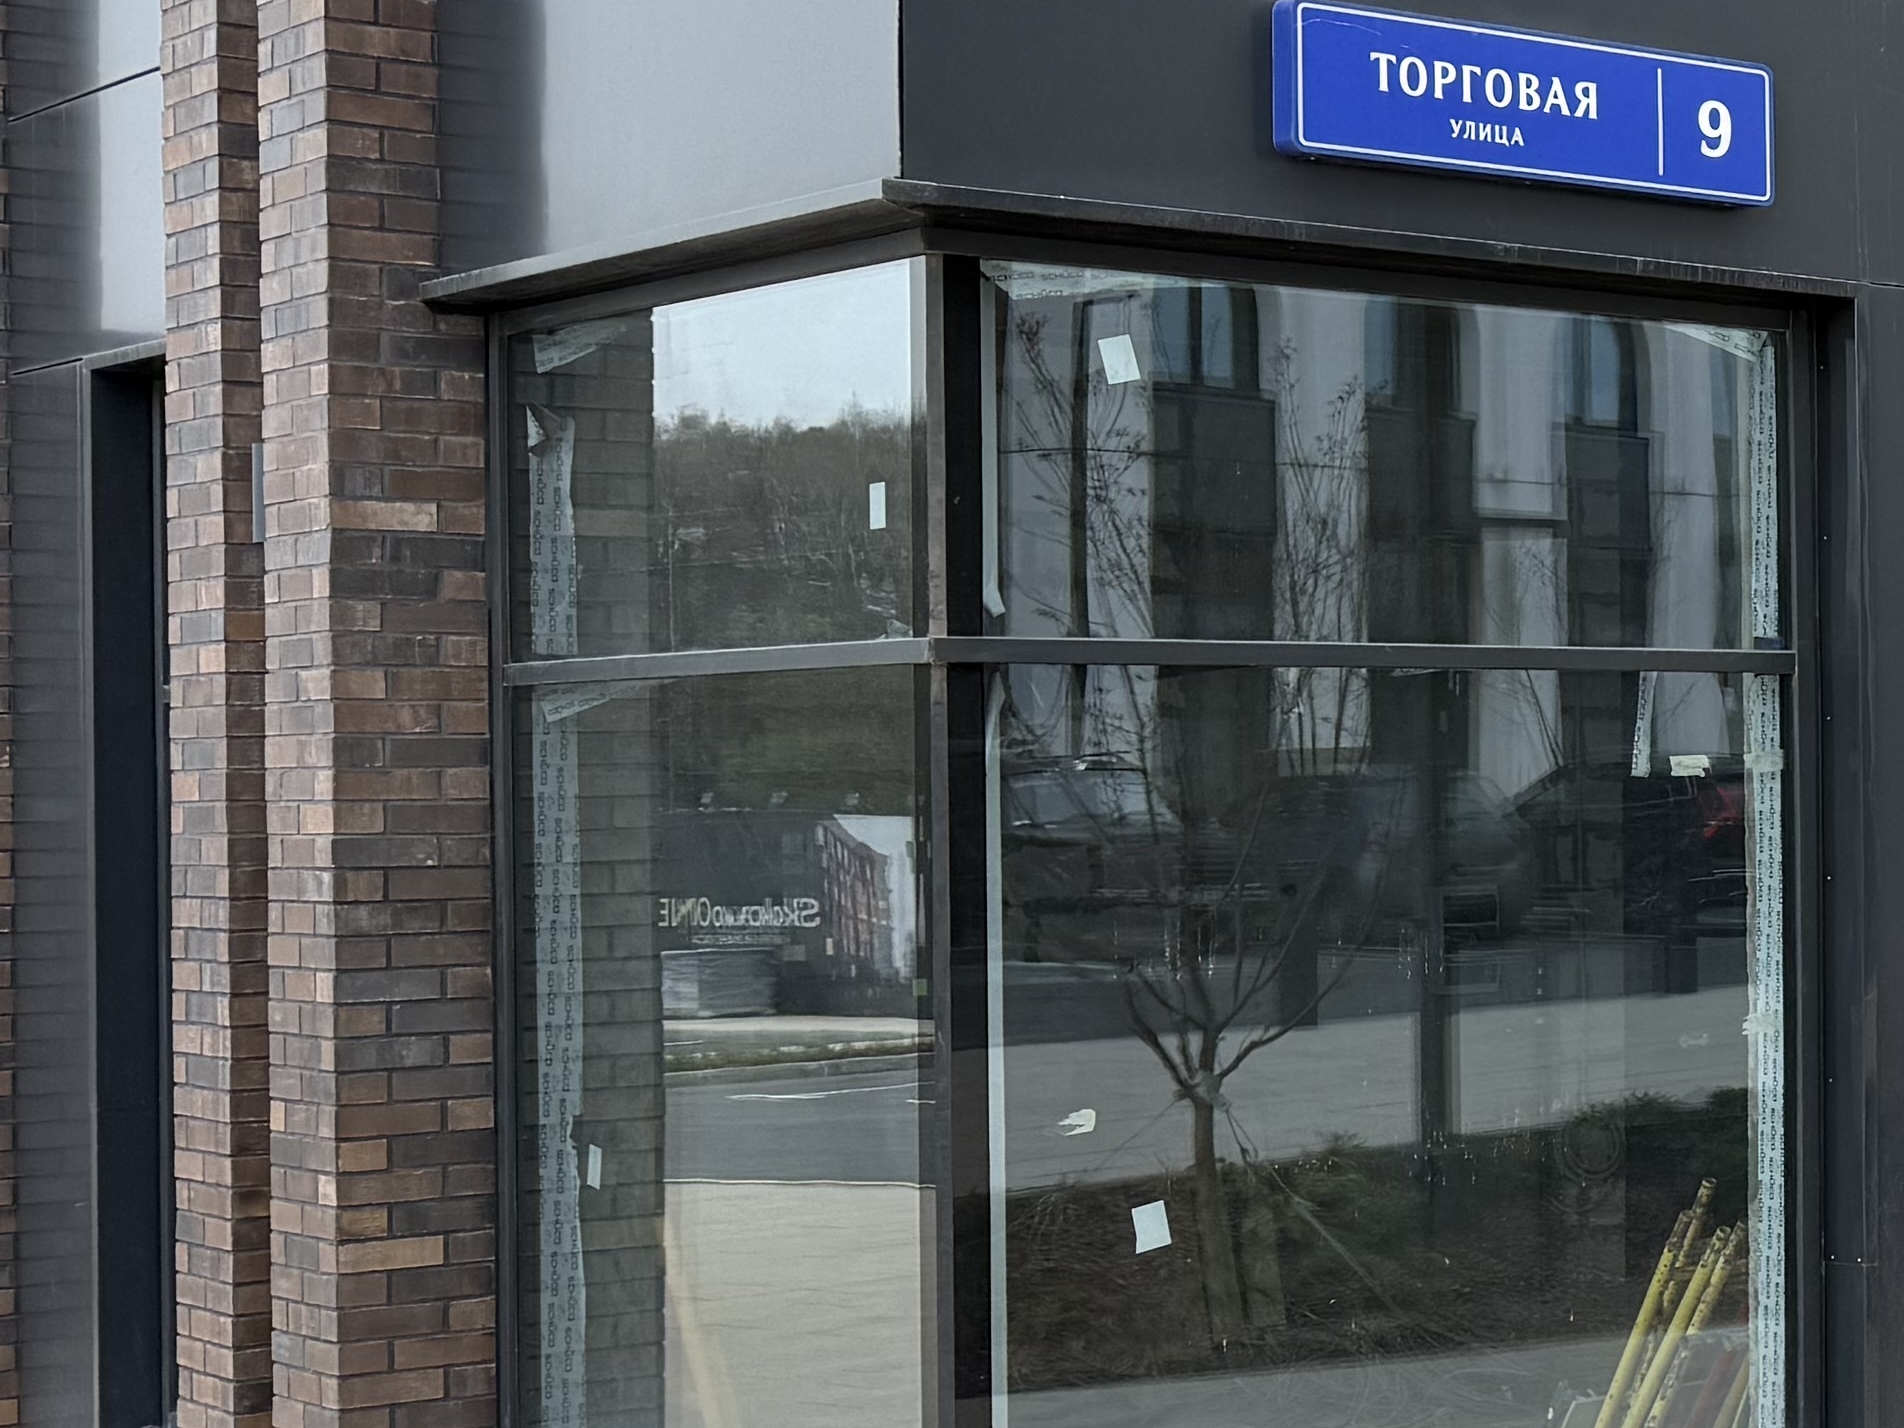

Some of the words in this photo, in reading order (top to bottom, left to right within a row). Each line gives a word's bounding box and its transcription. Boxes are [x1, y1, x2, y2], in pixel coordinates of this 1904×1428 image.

[1369, 51, 1599, 120] ТОРГОВАЯ
[1449, 118, 1525, 147] УЛИЦА
[1697, 100, 1732, 158] 9
